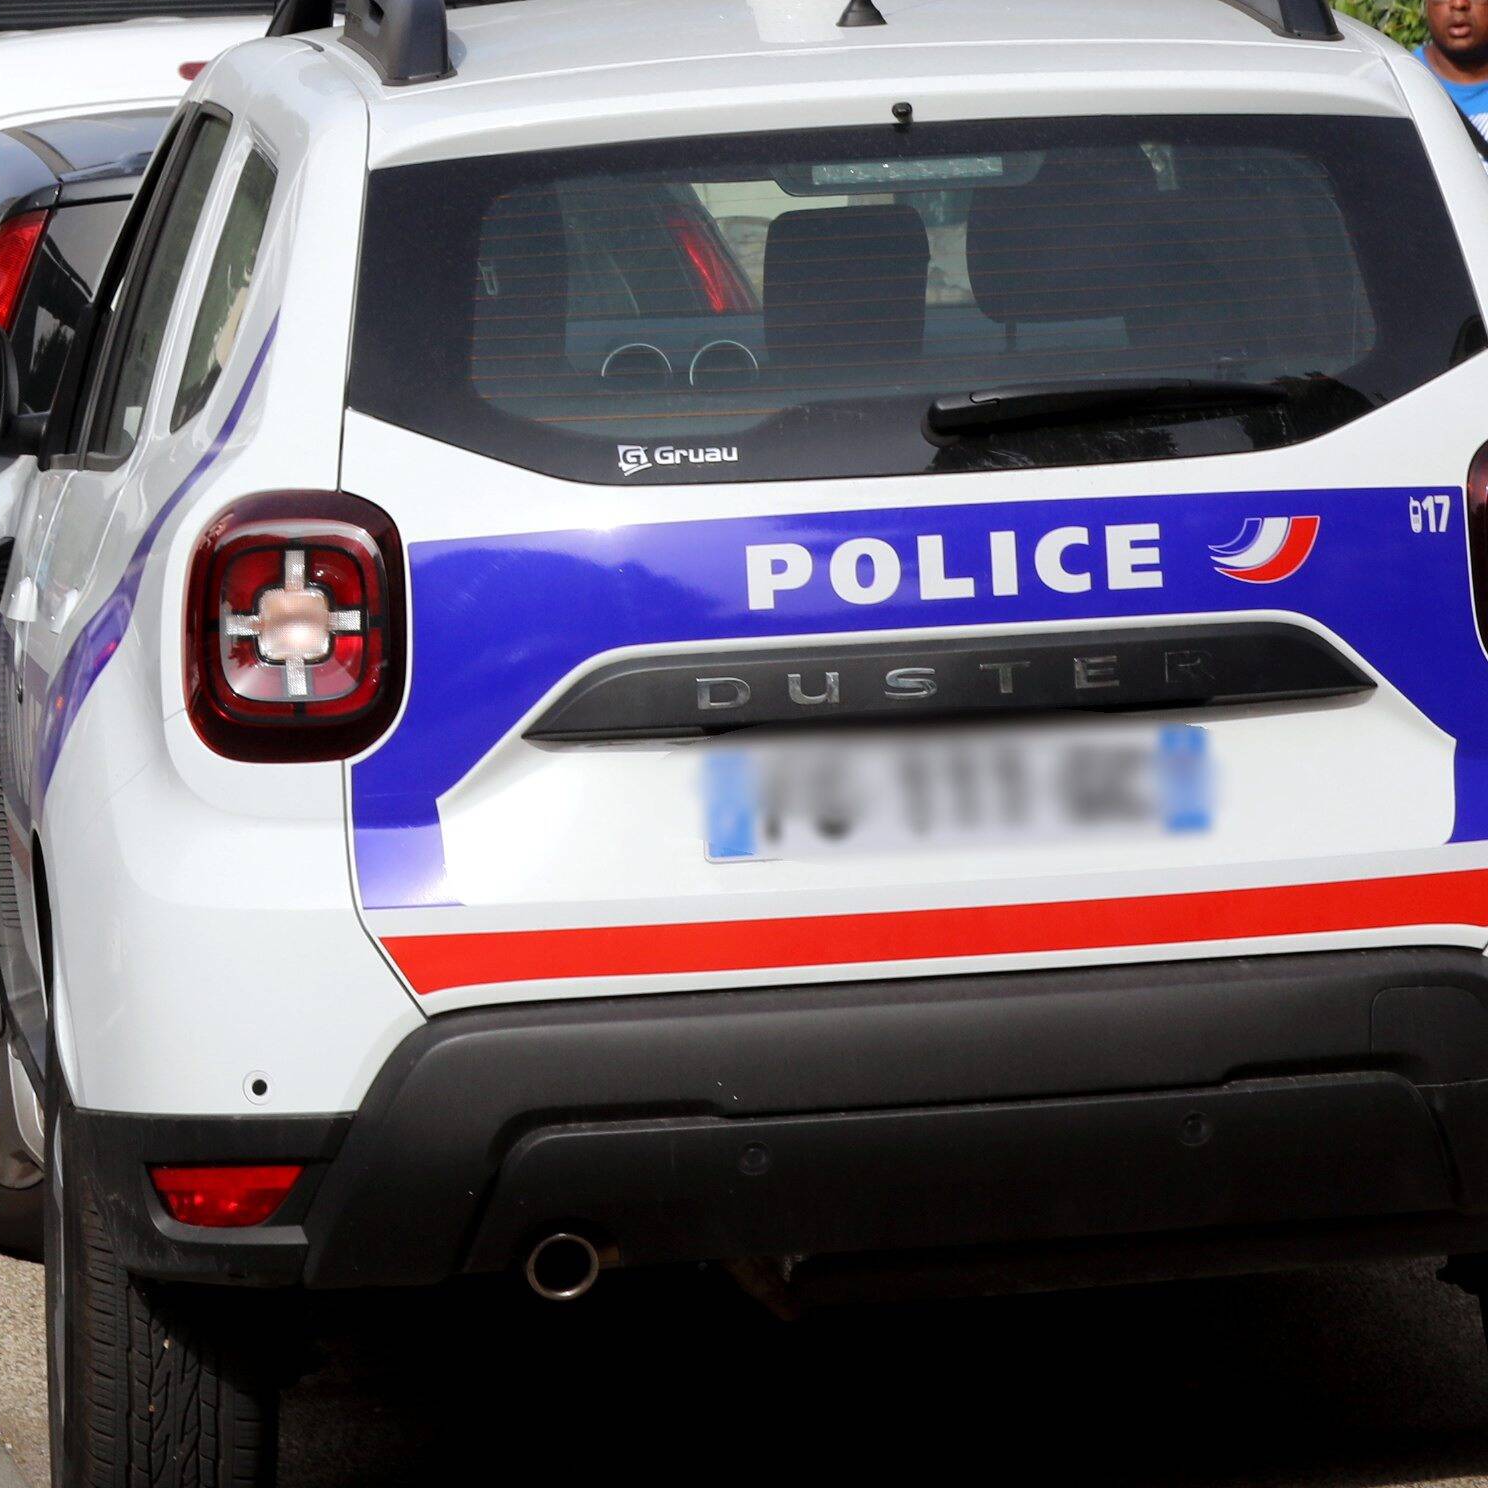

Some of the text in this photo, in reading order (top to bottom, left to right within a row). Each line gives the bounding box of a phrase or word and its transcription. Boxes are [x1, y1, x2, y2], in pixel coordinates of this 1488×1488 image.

[654, 446, 739, 465] Gruau
[746, 495, 1451, 610] POLICE 17
[696, 649, 1217, 710] DUSTER
